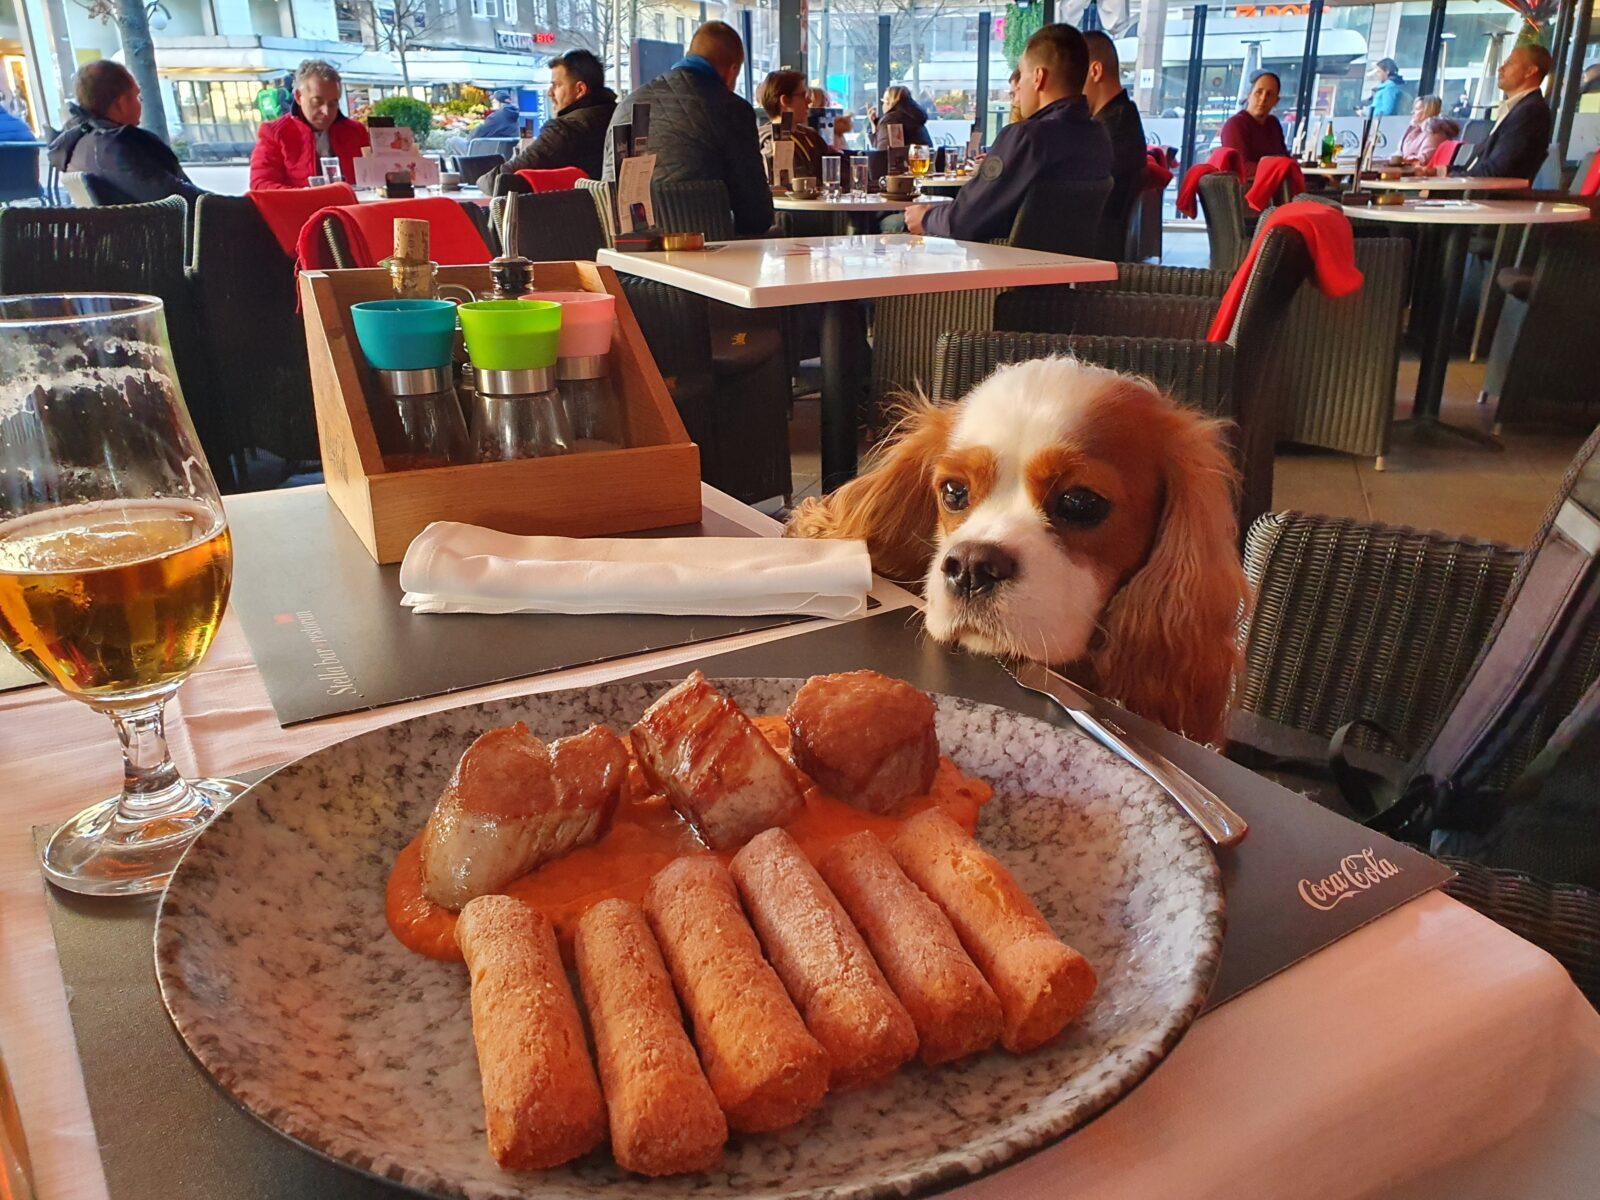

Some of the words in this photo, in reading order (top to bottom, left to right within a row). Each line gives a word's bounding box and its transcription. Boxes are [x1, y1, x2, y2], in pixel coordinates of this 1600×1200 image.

[313, 648, 341, 668] bar
[318, 666, 357, 695] Stella
[1298, 847, 1399, 911] Coca-Cola
